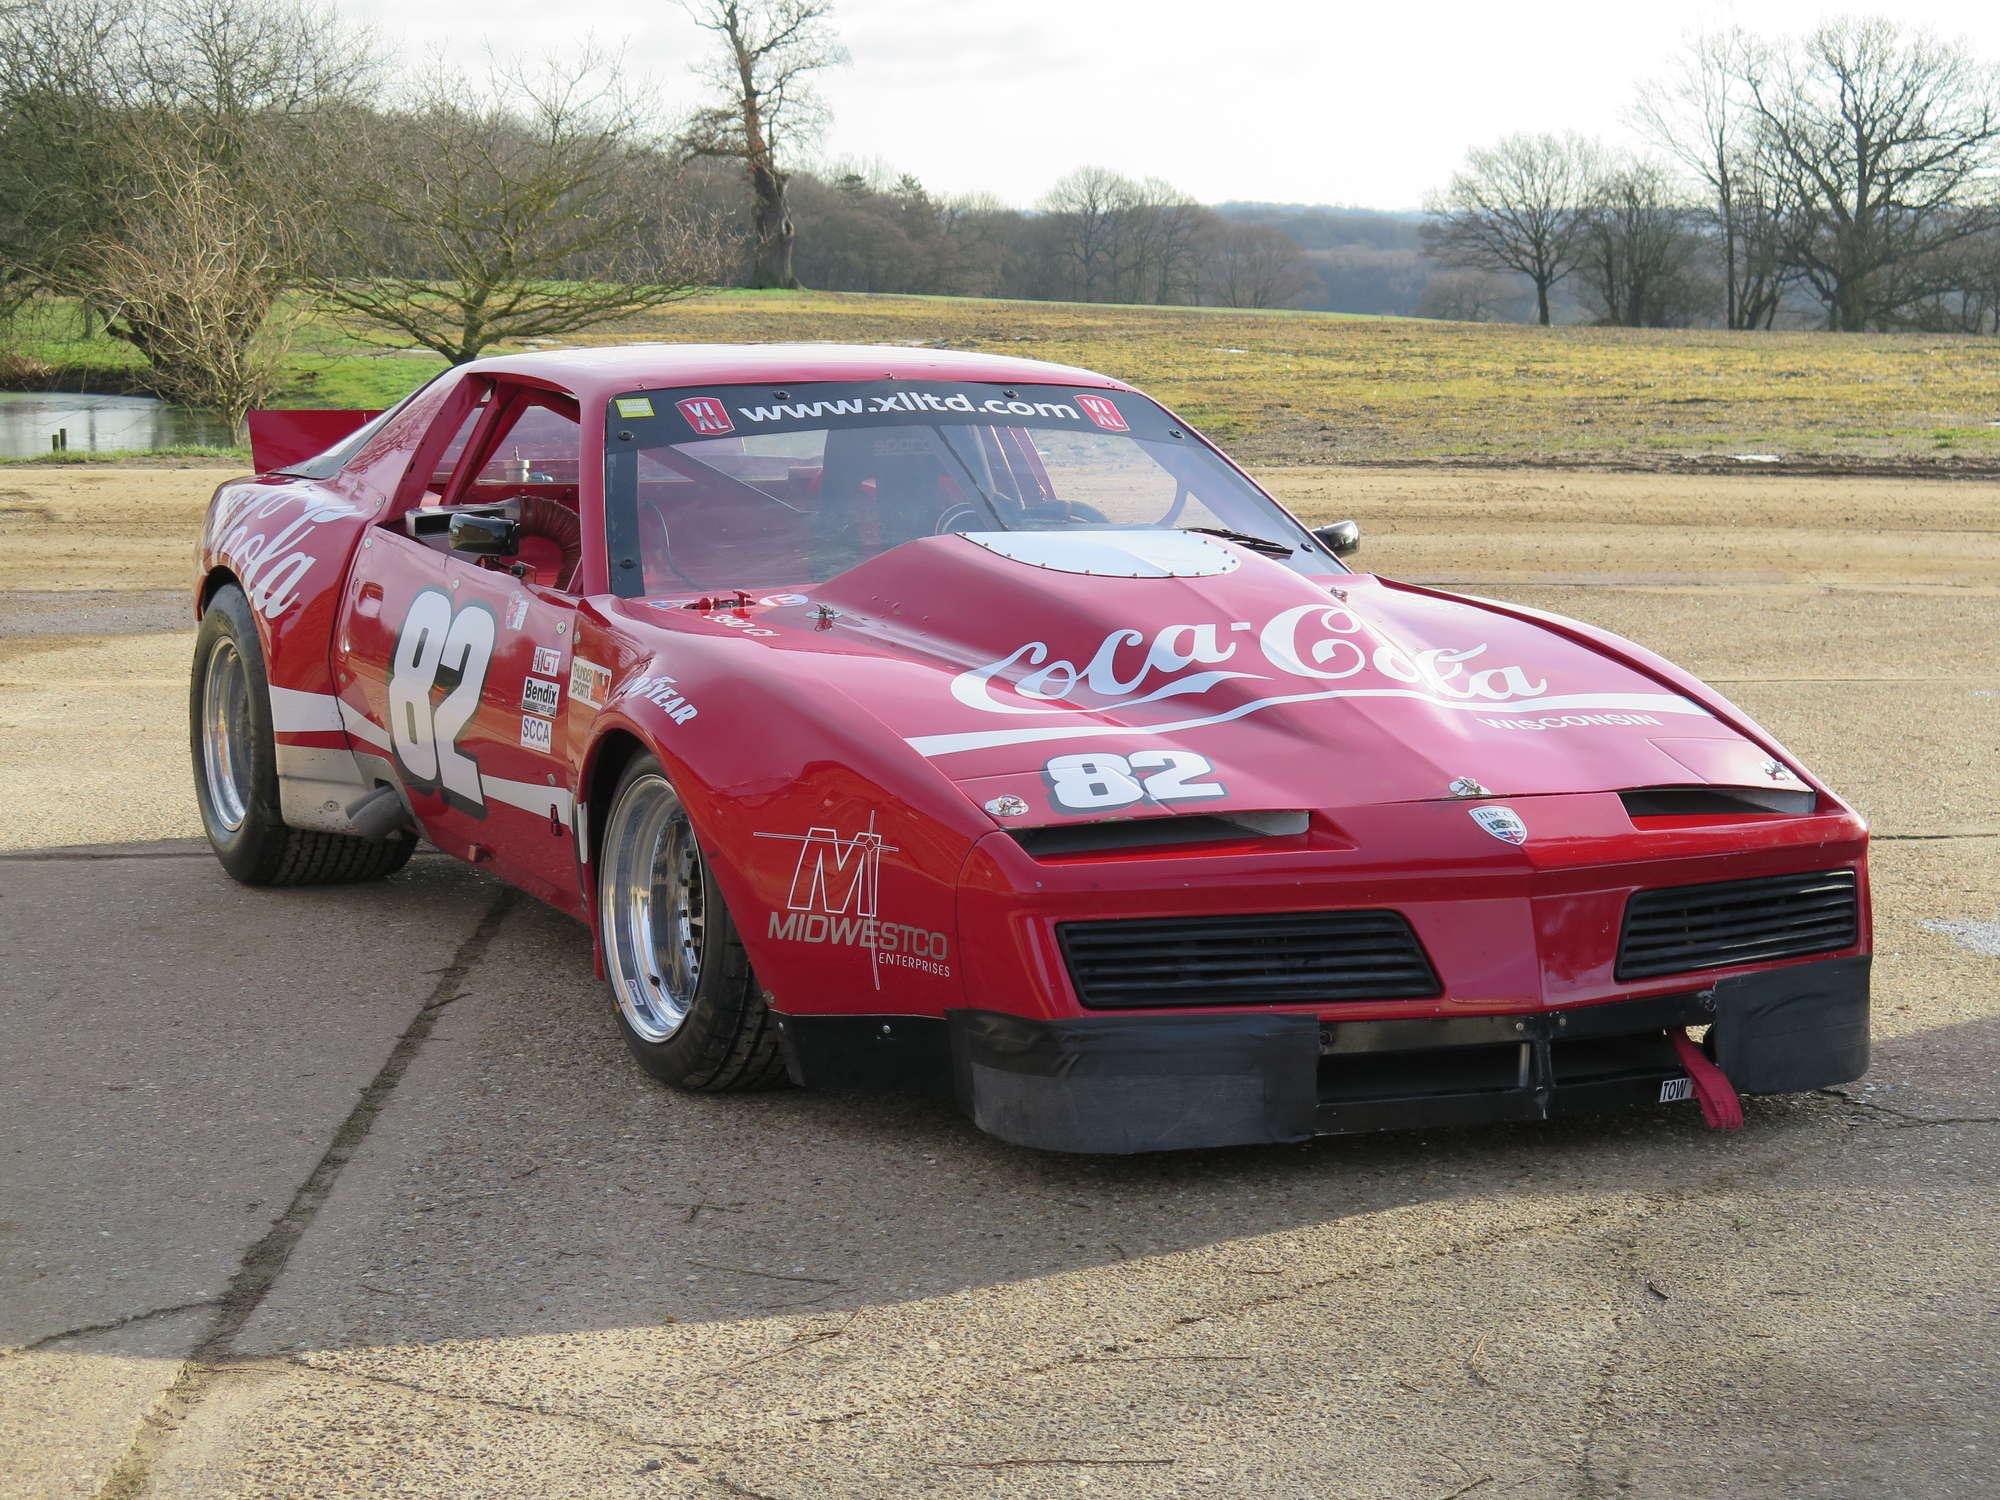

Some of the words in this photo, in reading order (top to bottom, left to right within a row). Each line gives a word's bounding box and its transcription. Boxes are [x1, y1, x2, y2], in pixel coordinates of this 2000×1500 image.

[738, 391, 1080, 422] www.xlltd.com
[951, 604, 1547, 714] Coca-Cola
[389, 590, 494, 806] 82
[524, 680, 557, 706] Bendix
[522, 718, 550, 744] SCCA
[1476, 713, 1664, 731] WISCONSIN
[1046, 750, 1215, 808] 82
[768, 911, 947, 960] MIDWESTCO
[879, 952, 950, 977] ENTERPRISES
[1663, 1079, 1688, 1101] TOW
